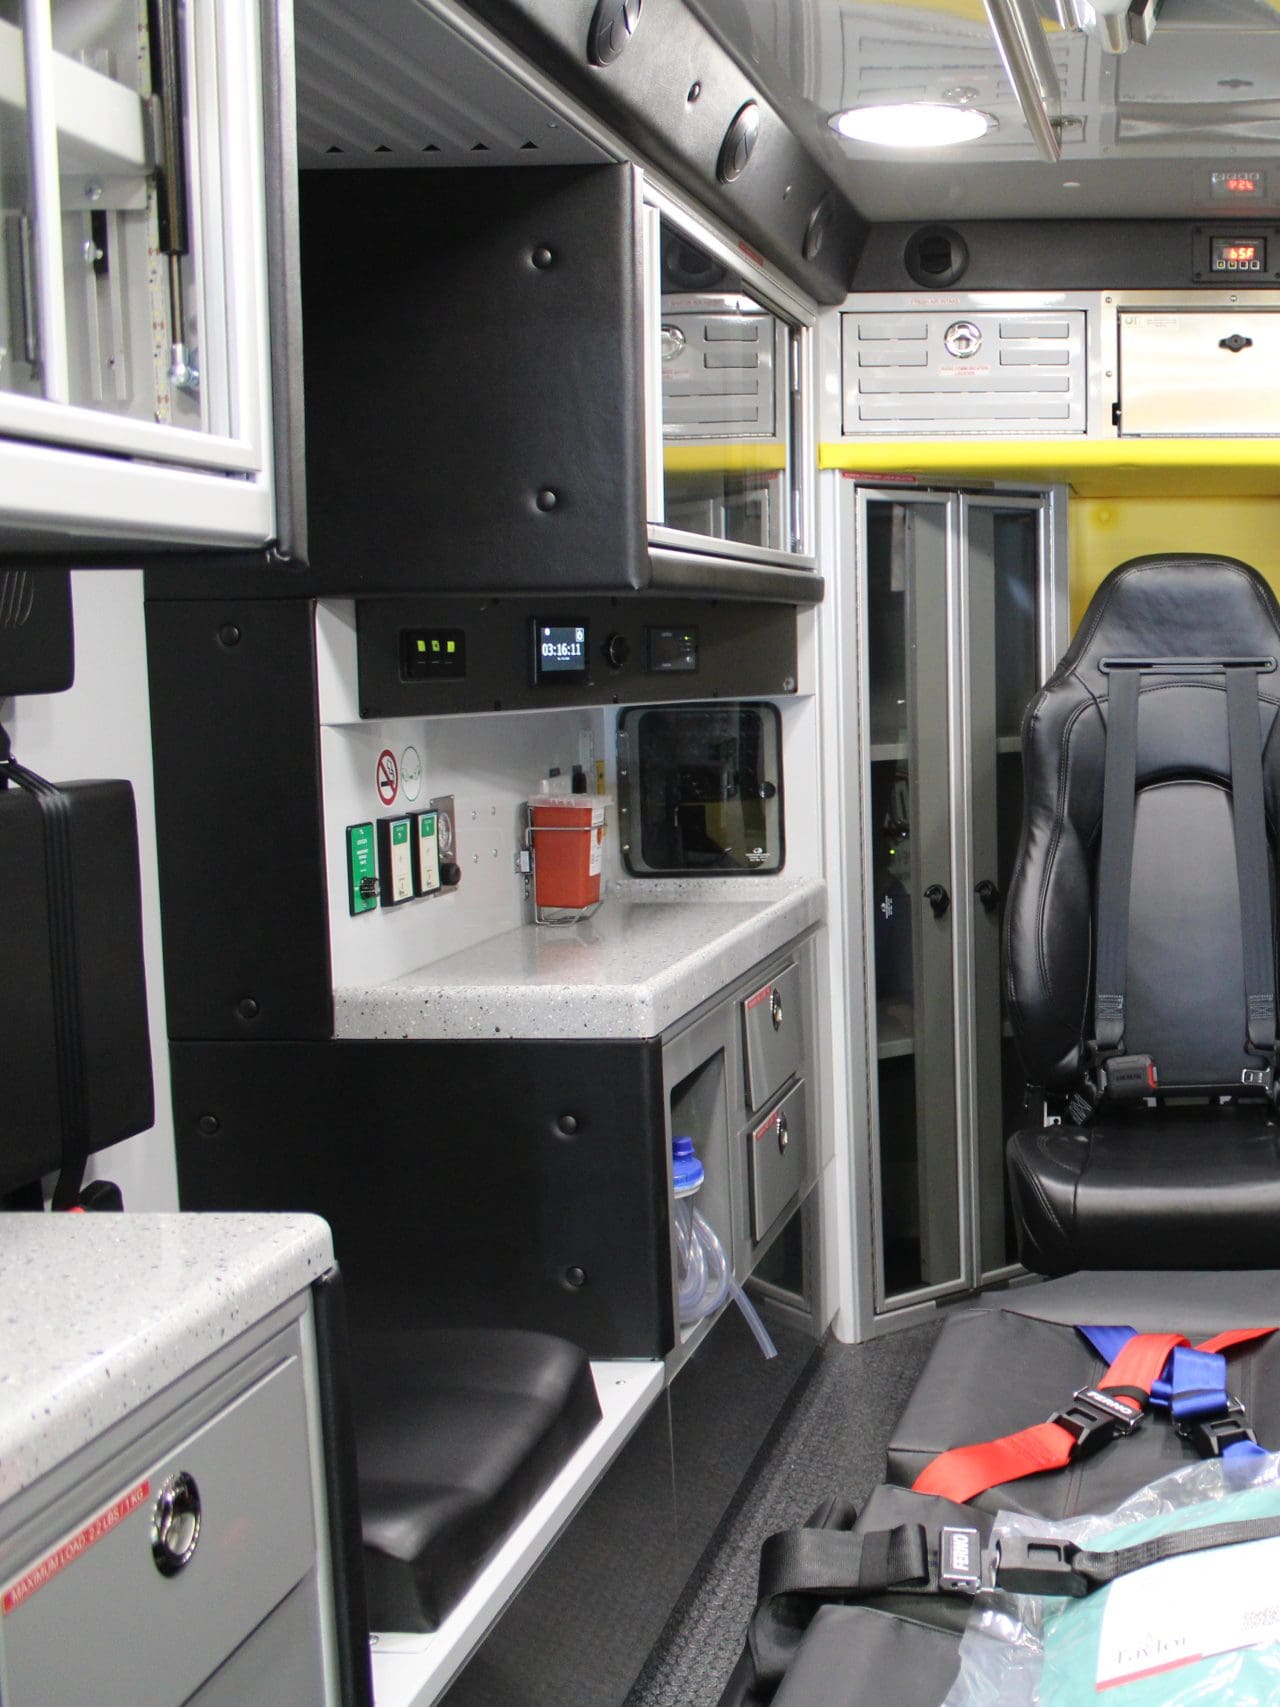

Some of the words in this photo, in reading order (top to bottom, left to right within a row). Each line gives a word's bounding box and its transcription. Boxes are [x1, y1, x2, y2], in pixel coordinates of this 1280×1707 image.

[542, 643, 581, 656] 03:16:11
[1087, 1391, 1133, 1414] FERNO
[12, 1557, 59, 1603] MAXIMUM
[102, 1510, 120, 1531] LBS
[952, 1533, 969, 1571] FERNO
